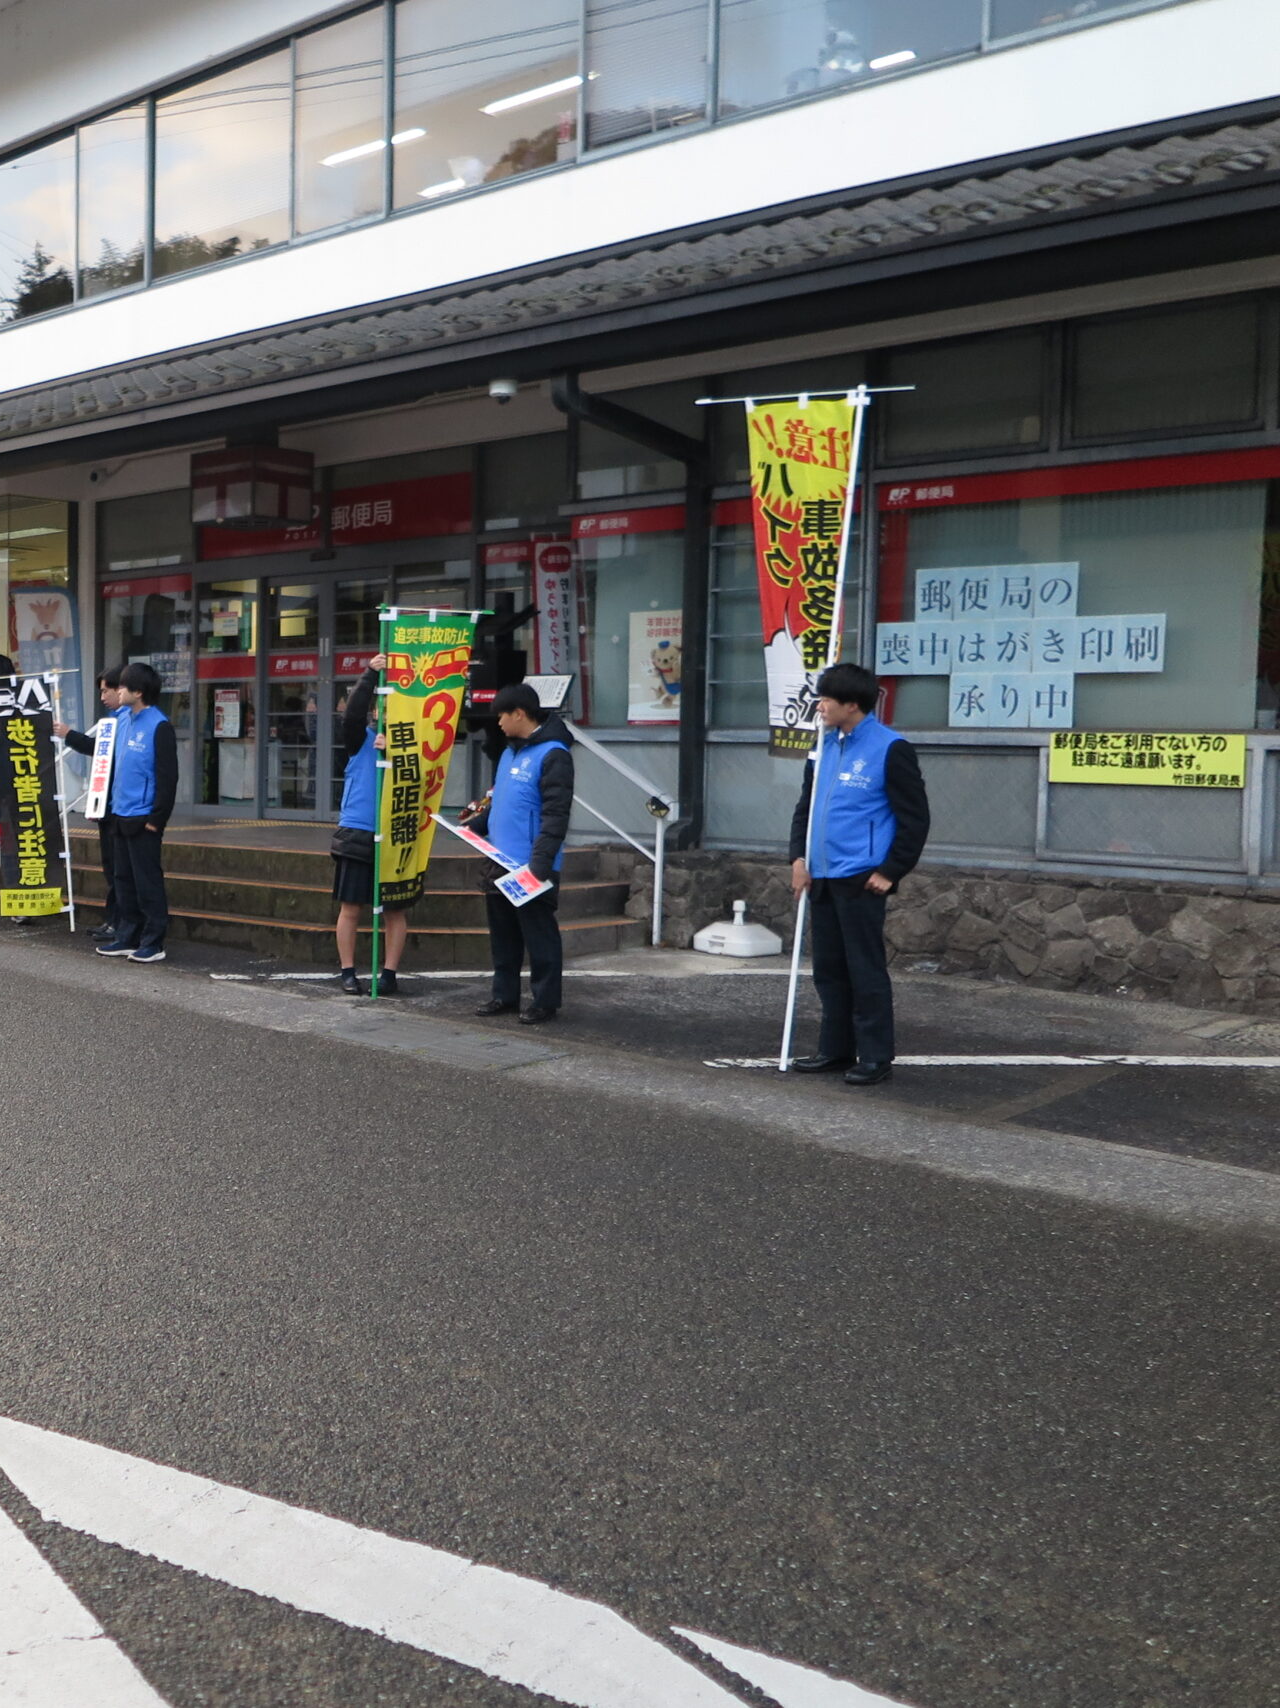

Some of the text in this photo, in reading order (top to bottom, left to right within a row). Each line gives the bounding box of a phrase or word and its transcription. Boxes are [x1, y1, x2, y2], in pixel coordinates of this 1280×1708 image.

[330, 501, 392, 531] 郵便局
[921, 575, 1073, 614] 郵便局の
[394, 626, 470, 645] 追突事故防止
[880, 624, 1160, 667] 喪中はがき印刷
[954, 684, 1068, 719] 承り中
[91, 723, 114, 793] 速度注意
[1054, 733, 1227, 752] 郵便局をご利用でない方の
[1072, 751, 1202, 771] 駐車はご遠慮願います。
[1172, 774, 1241, 787] 竹田郵便局長
[388, 721, 420, 875] 車間距離!!
